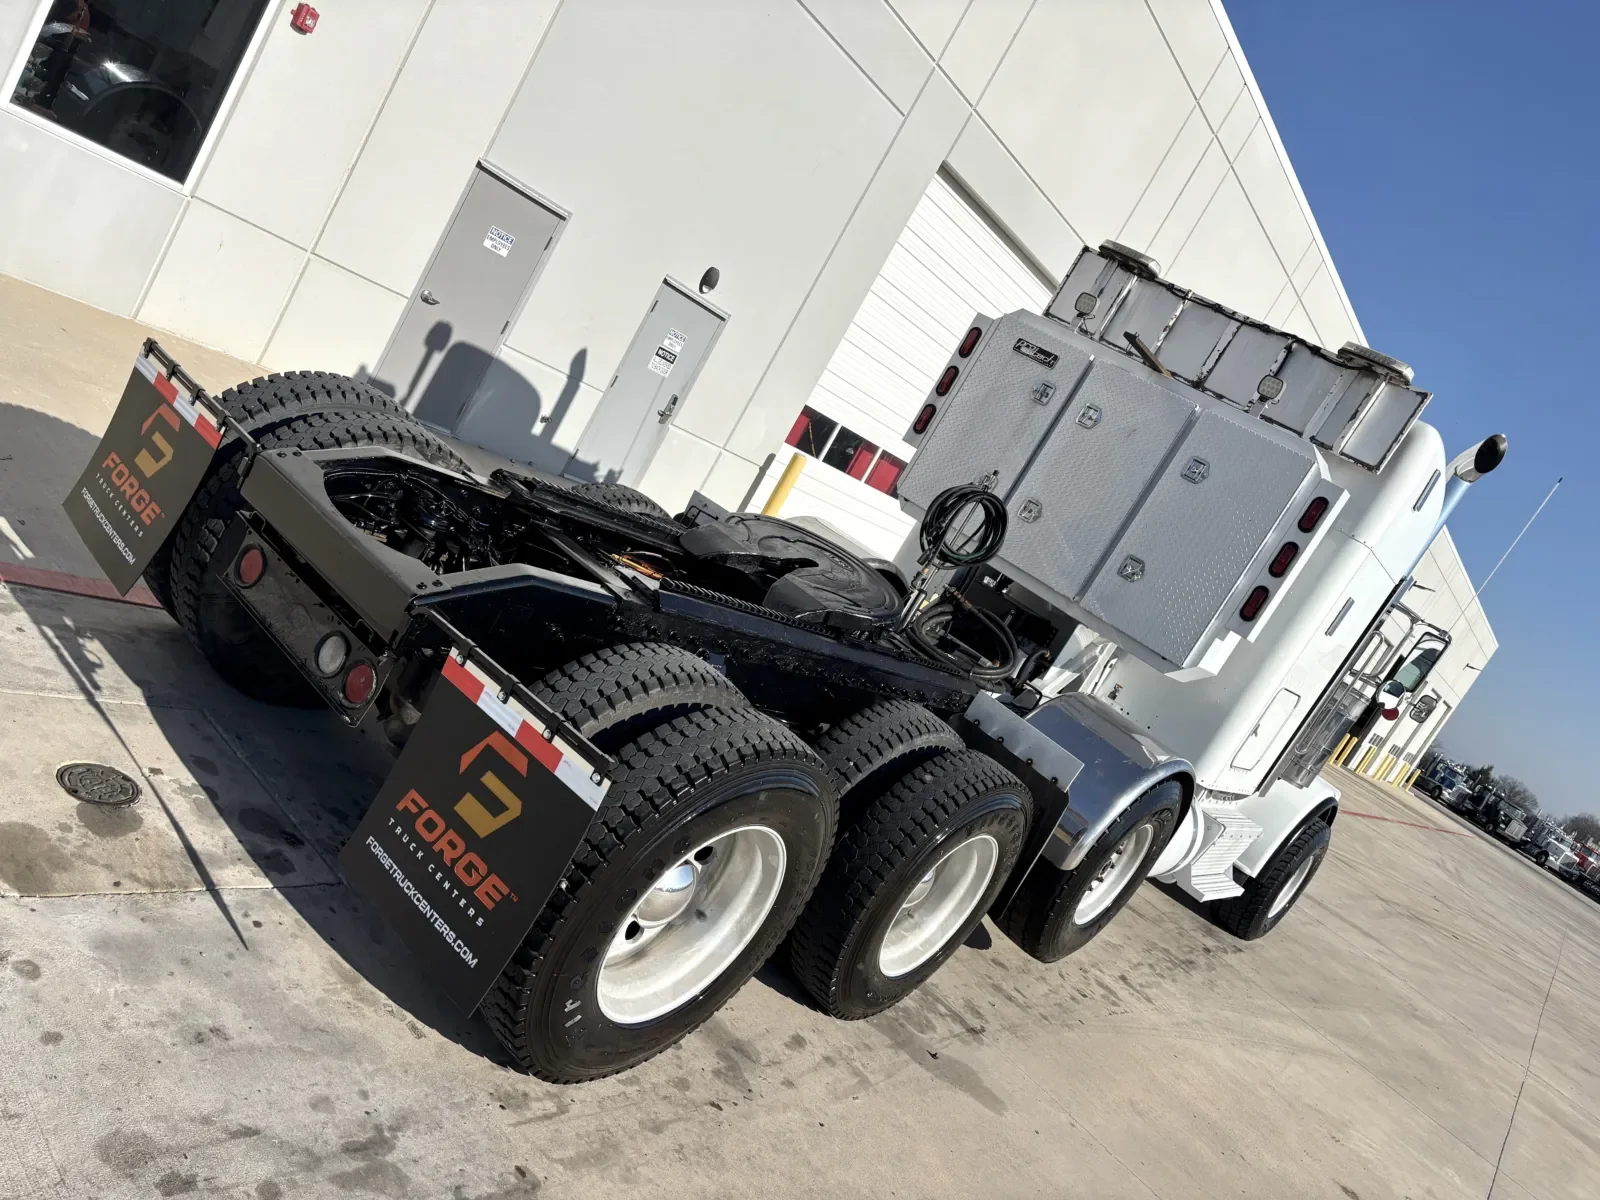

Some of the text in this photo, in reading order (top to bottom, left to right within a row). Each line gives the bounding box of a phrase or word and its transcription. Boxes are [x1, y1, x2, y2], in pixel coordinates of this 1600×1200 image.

[487, 234, 511, 251] EMPLOYEES
[490, 227, 514, 245] NOTICE
[491, 244, 502, 252] ONLY
[657, 348, 675, 362] NOTICE
[95, 472, 144, 538] TRUCK CENTERS
[102, 451, 162, 526] FORGE
[80, 487, 137, 566] FORGETRUCKCENTERS.COM
[387, 817, 485, 927] TRUCK CENTERS
[395, 788, 511, 911] FORGE
[365, 835, 479, 969] FORGETRUCKCENTERS.COM
